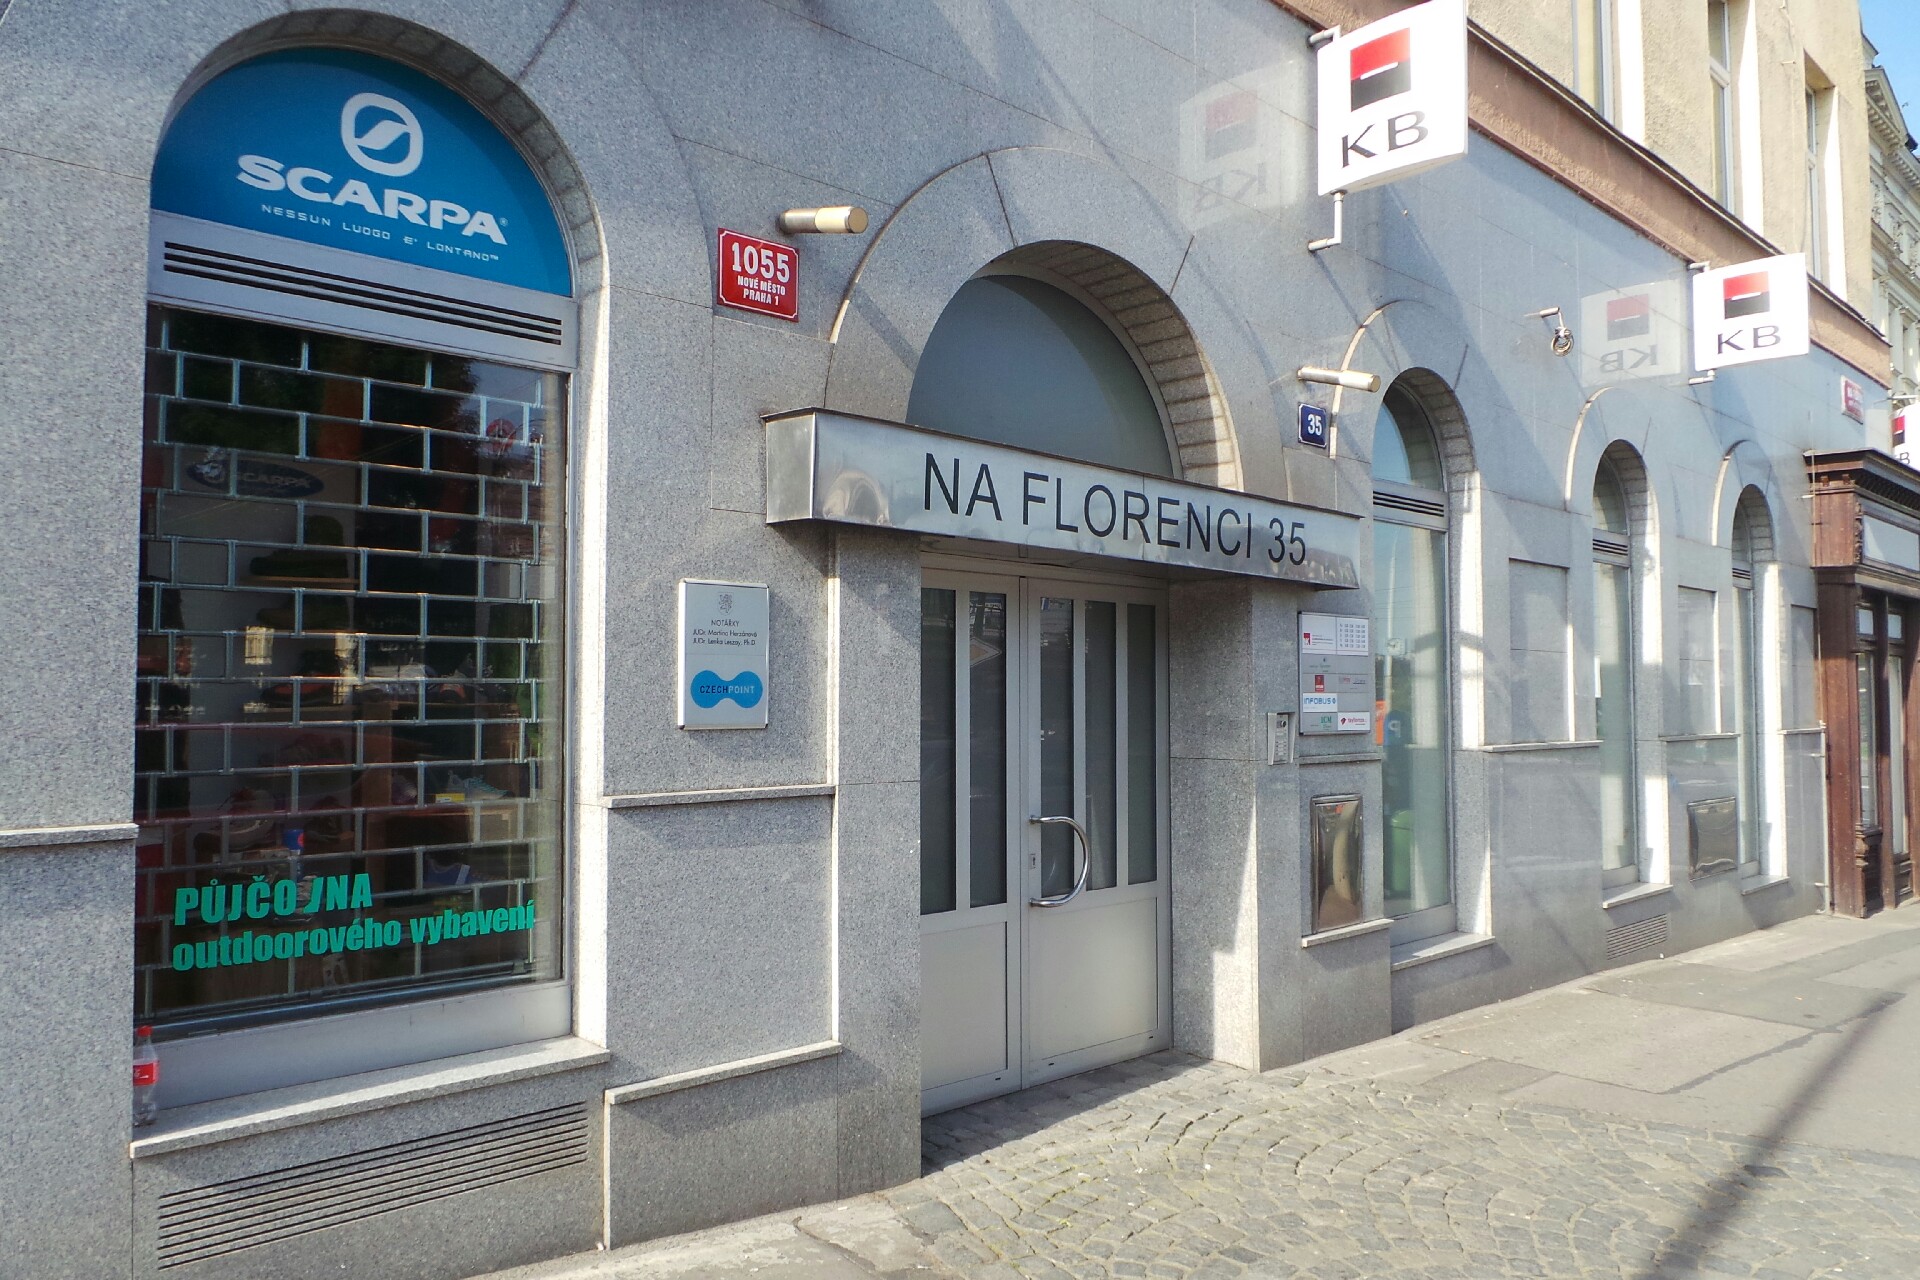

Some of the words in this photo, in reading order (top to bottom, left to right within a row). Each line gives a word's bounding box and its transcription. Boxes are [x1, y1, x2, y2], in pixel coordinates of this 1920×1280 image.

[1341, 110, 1429, 168] KB
[261, 204, 331, 227] NESSUN
[343, 222, 391, 240] LUOGO
[731, 242, 790, 283] 1055
[737, 274, 759, 289] NOVÉ
[760, 280, 786, 296] MĚSTO
[743, 288, 772, 304] PRAHA
[774, 295, 779, 306] 1
[1716, 325, 1782, 354] KB
[1307, 413, 1323, 436] 35
[238, 471, 312, 488] CARPA
[924, 452, 1003, 522] NA
[1022, 470, 1252, 560] FLORENCI
[1268, 521, 1307, 566] 35
[171, 917, 402, 972] outdoorového
[409, 899, 536, 946] vybavení
